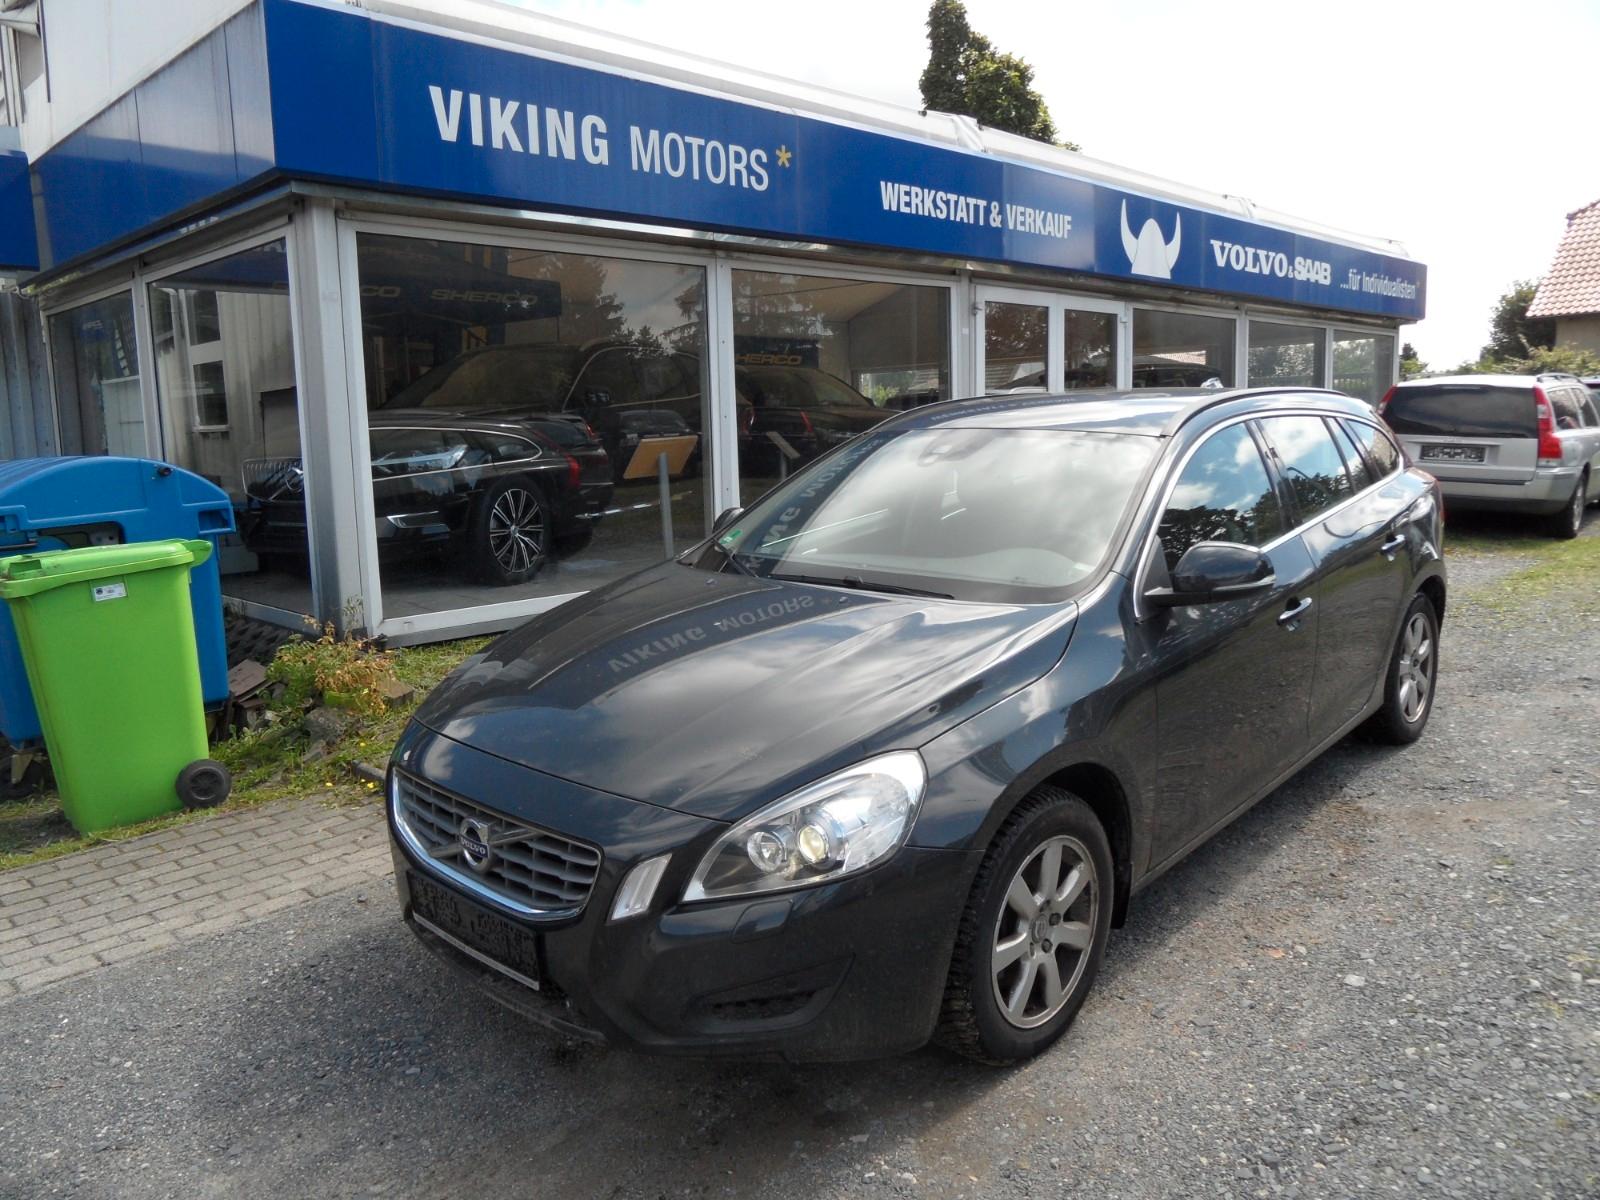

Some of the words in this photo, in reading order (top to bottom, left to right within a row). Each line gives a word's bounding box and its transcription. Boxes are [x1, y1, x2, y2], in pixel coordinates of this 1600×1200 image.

[428, 85, 609, 166] VIKING
[630, 125, 769, 192] MOTORS
[880, 180, 987, 226] WERKSTATT
[989, 201, 1002, 228] &
[1006, 203, 1072, 239] VERKAUF
[1362, 271, 1416, 300] Individualisten
